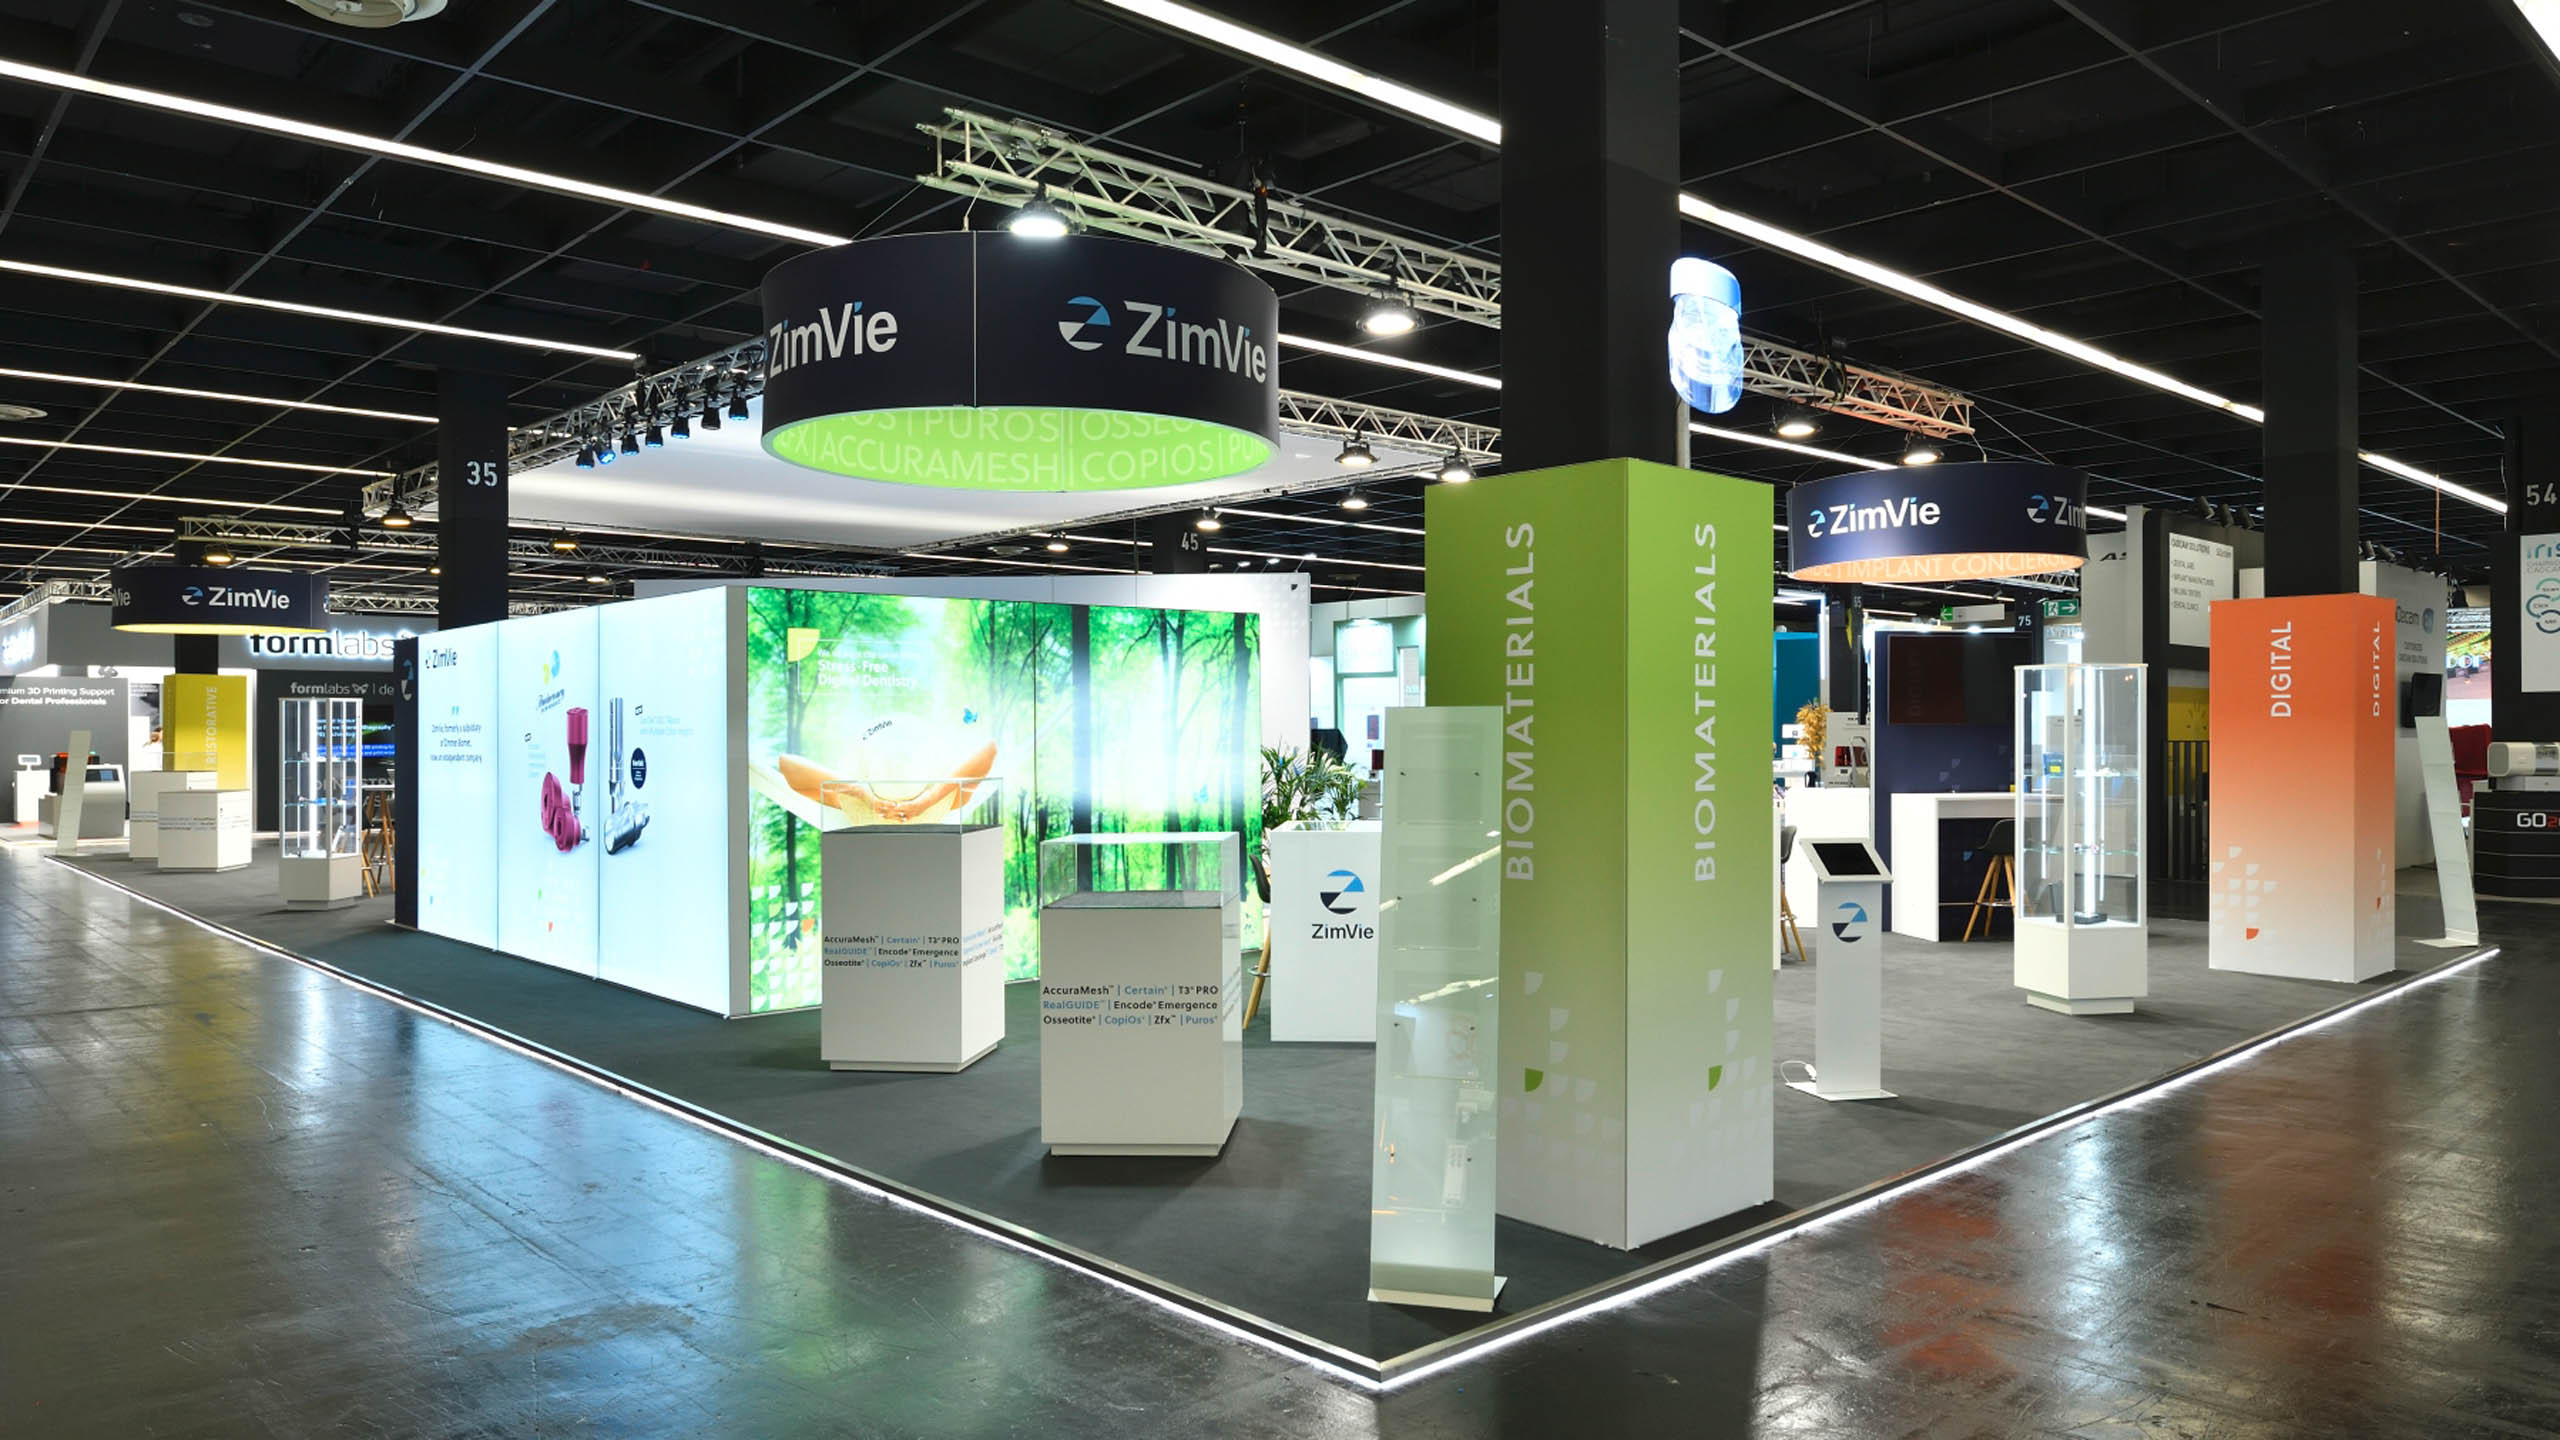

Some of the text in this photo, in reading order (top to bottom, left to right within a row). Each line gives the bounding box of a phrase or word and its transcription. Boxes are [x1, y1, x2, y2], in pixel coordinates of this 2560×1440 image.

[770, 301, 898, 378] ZimVie
[1124, 300, 1266, 383] ZimVie
[820, 430, 1058, 484] ACCURAMESH
[1081, 440, 1214, 482] COPIOS
[466, 461, 498, 486] 35
[2527, 482, 2558, 506] 54
[1829, 496, 1940, 536] ZimVie
[1181, 531, 1199, 551] 45
[1847, 557, 1943, 578] IMPLANT
[208, 587, 290, 609] ZimVie
[2018, 616, 2032, 627] 75
[250, 630, 394, 657] formlabs
[2271, 620, 2292, 718] DIGITAL
[2372, 620, 2381, 717] DIGITAL
[27, 687, 41, 695] 3D
[43, 687, 78, 698] Printing
[79, 687, 115, 697] Support
[290, 682, 350, 695] formlabs
[11, 697, 43, 705] Dental
[45, 697, 107, 705] Professionals
[1506, 522, 1534, 881] BIOMATERIALS
[1695, 522, 1716, 881] BIOMATERIALS
[206, 687, 217, 765] RESTORATIVE
[2517, 812, 2560, 829] GO2
[1311, 923, 1374, 939] ZimVie
[1158, 1000, 1218, 1012] Emergence
